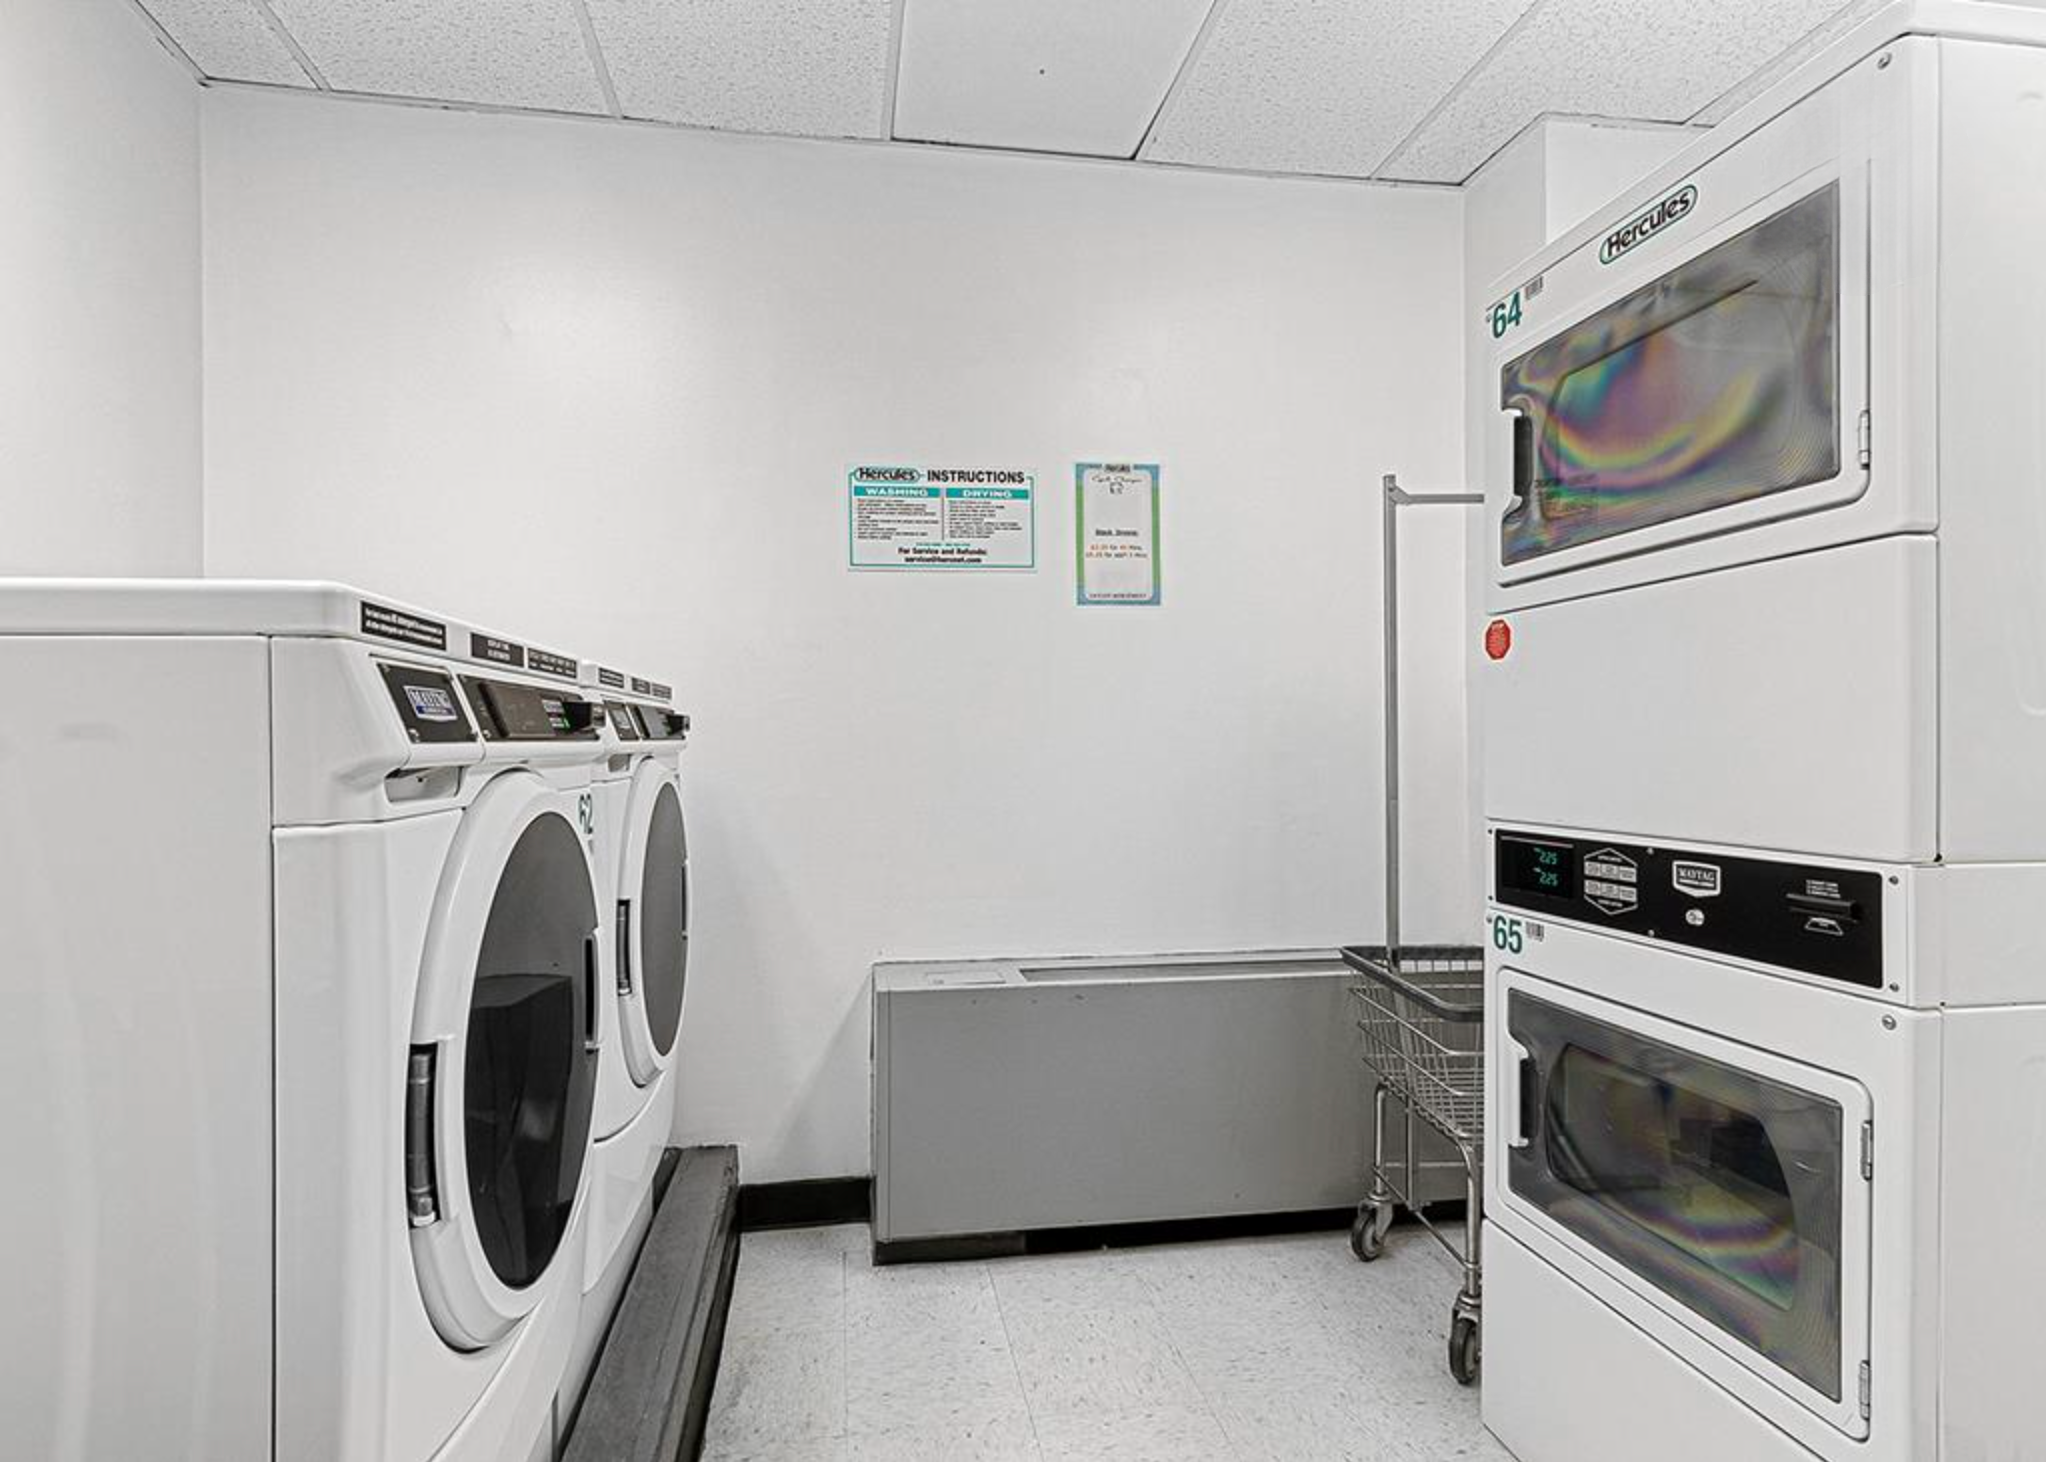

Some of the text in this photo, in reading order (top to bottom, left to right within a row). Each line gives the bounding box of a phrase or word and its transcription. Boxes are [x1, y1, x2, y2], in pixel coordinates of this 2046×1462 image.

[1606, 189, 1690, 258] Hercules
[1491, 291, 1523, 339] 64
[858, 467, 1025, 483] Hercules INSTRUCTIONS
[866, 487, 928, 497] WASHING
[962, 489, 1012, 498] DRYING
[912, 547, 939, 555] Service
[578, 793, 593, 834] 62
[1678, 867, 1715, 882] MAYTAG
[1493, 915, 1523, 954] 65
